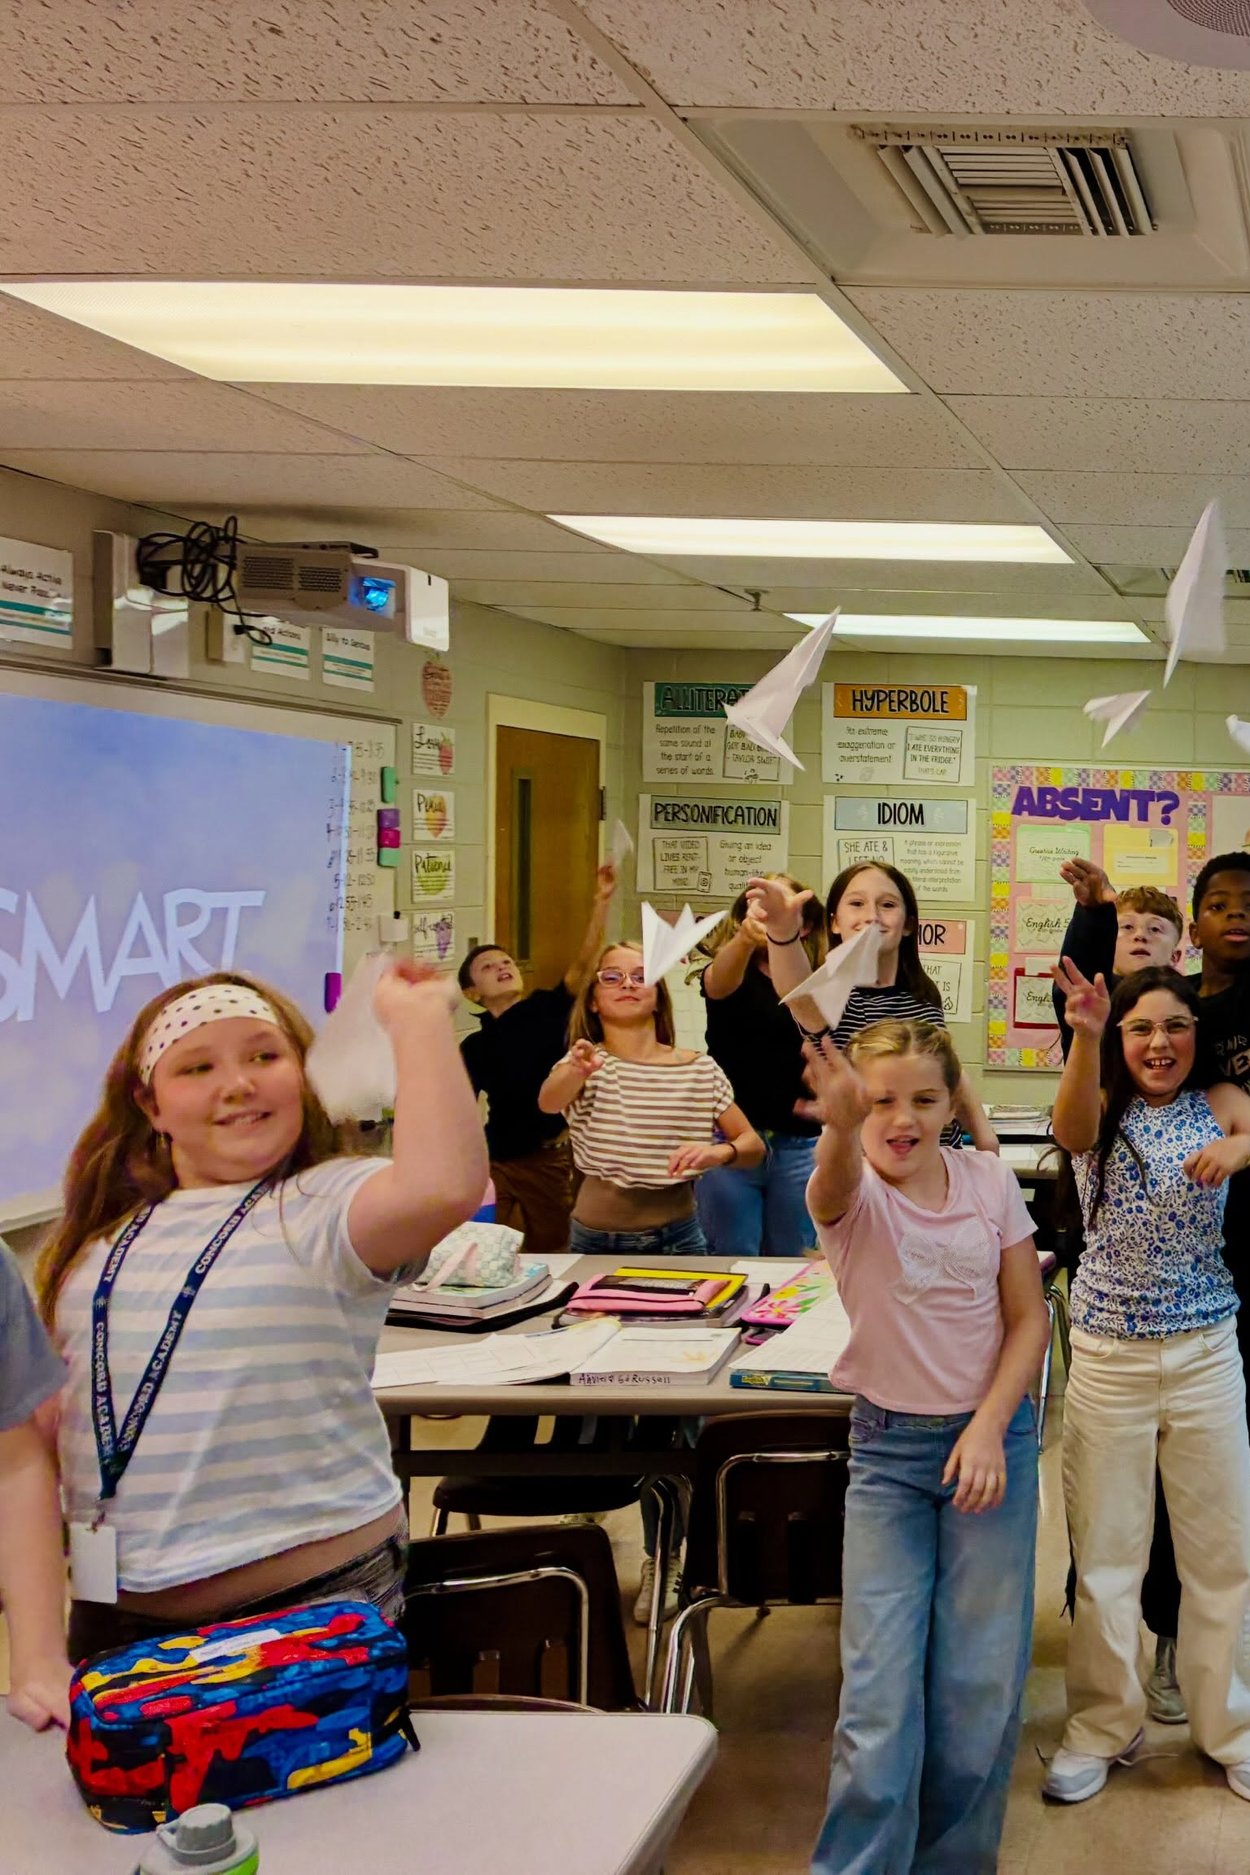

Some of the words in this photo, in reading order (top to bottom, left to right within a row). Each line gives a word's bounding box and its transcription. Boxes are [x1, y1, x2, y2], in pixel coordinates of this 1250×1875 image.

[852, 689, 949, 713] HYPERBOLE
[656, 724, 692, 734] Repetition
[693, 725, 701, 734] of
[704, 725, 716, 734] the
[837, 741, 885, 752] exaggeration
[661, 752, 673, 761] the
[839, 755, 892, 764] overstatement
[681, 766, 689, 775] of
[878, 802, 924, 825] IDIOM
[1011, 785, 1180, 826] ABSENT?
[654, 803, 777, 827] PERSONIFICATION
[844, 841, 860, 853] SHE
[863, 841, 878, 852] ATE
[883, 841, 888, 851] &
[1025, 916, 1061, 932] English
[942, 981, 951, 991] IS
[194, 1214, 242, 1274] CONCORD
[148, 1309, 182, 1382] ACADEMY
[95, 1322, 107, 1393] CONCORD
